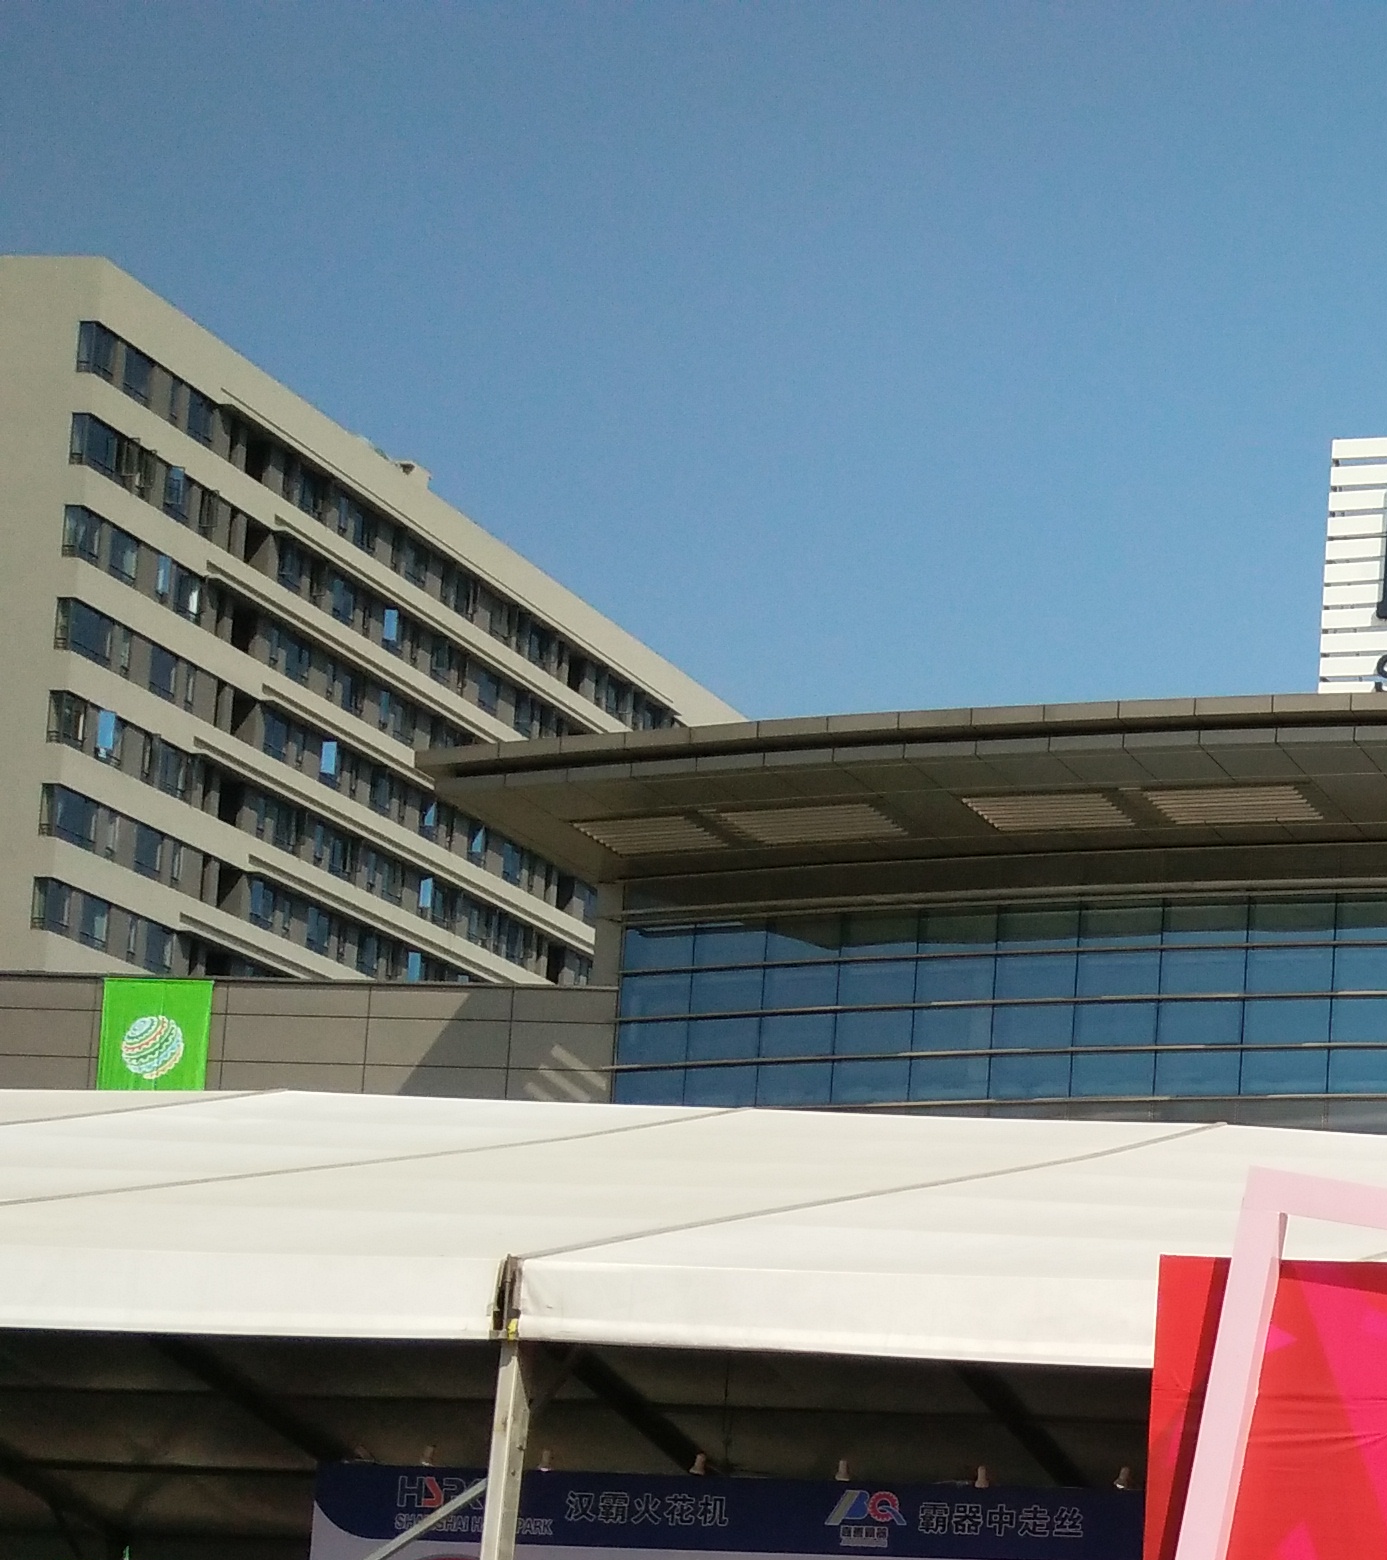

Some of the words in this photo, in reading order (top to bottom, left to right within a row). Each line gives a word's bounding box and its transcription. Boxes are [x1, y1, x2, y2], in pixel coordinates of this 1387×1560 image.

[565, 1490, 729, 1527] 汉霸火花机
[918, 1501, 1084, 1538] 霸器中走丝
